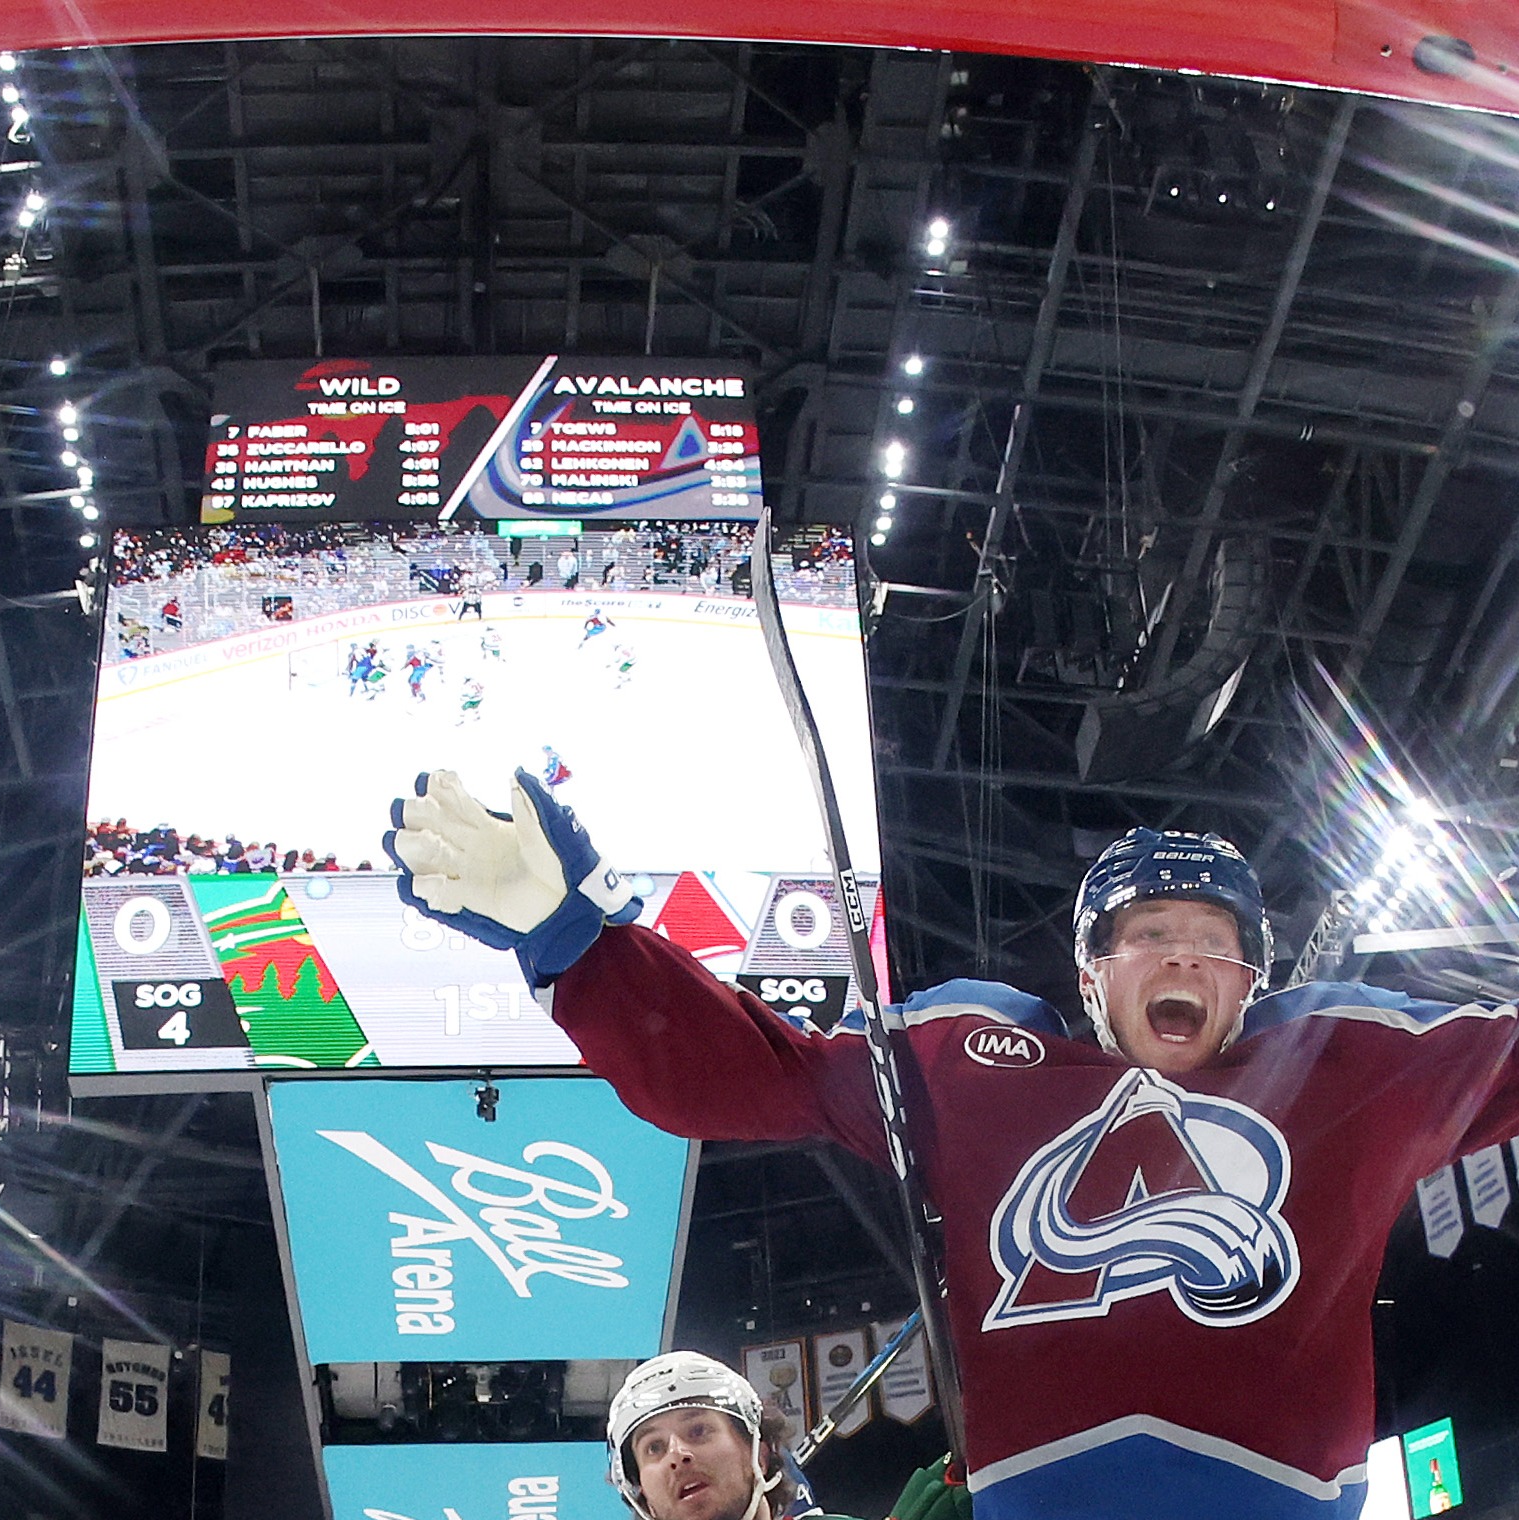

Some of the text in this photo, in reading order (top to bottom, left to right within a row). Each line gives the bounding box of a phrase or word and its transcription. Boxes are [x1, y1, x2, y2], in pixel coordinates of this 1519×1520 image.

[318, 376, 402, 397] WILD
[552, 375, 745, 398] AVALANCHE
[307, 401, 406, 415] TIME ON ICE
[591, 401, 692, 415] TIME ON ICE
[228, 426, 240, 438] 7
[530, 422, 542, 434] 7
[551, 423, 617, 435] TOEWS
[246, 441, 366, 456] ZUCCARELLO
[399, 440, 440, 453] 4:07
[551, 440, 662, 453] MACKINNON
[244, 459, 335, 473] HARTMAN
[402, 458, 439, 471] 4:01
[551, 457, 650, 471] LEHKONEN
[243, 476, 318, 490] HUGHES
[520, 474, 544, 487] 70
[551, 474, 639, 487] MALINSKI
[241, 493, 335, 508] KAPRIZOV
[693, 600, 758, 619] Energiz
[305, 612, 380, 638] HONDA
[221, 629, 298, 661] verizon
[1152, 850, 1216, 863] BAUER
[840, 873, 863, 928] CCM
[112, 896, 172, 956] 0
[774, 890, 832, 951] 0
[134, 982, 203, 1009] SOG
[759, 977, 828, 1002] SOG
[157, 1011, 192, 1047] 4
[976, 1032, 1032, 1061] IMA
[424, 1140, 631, 1299] Ball
[387, 1211, 459, 1336] Arena
[12, 1364, 58, 1404] 44
[108, 1379, 160, 1418] 55
